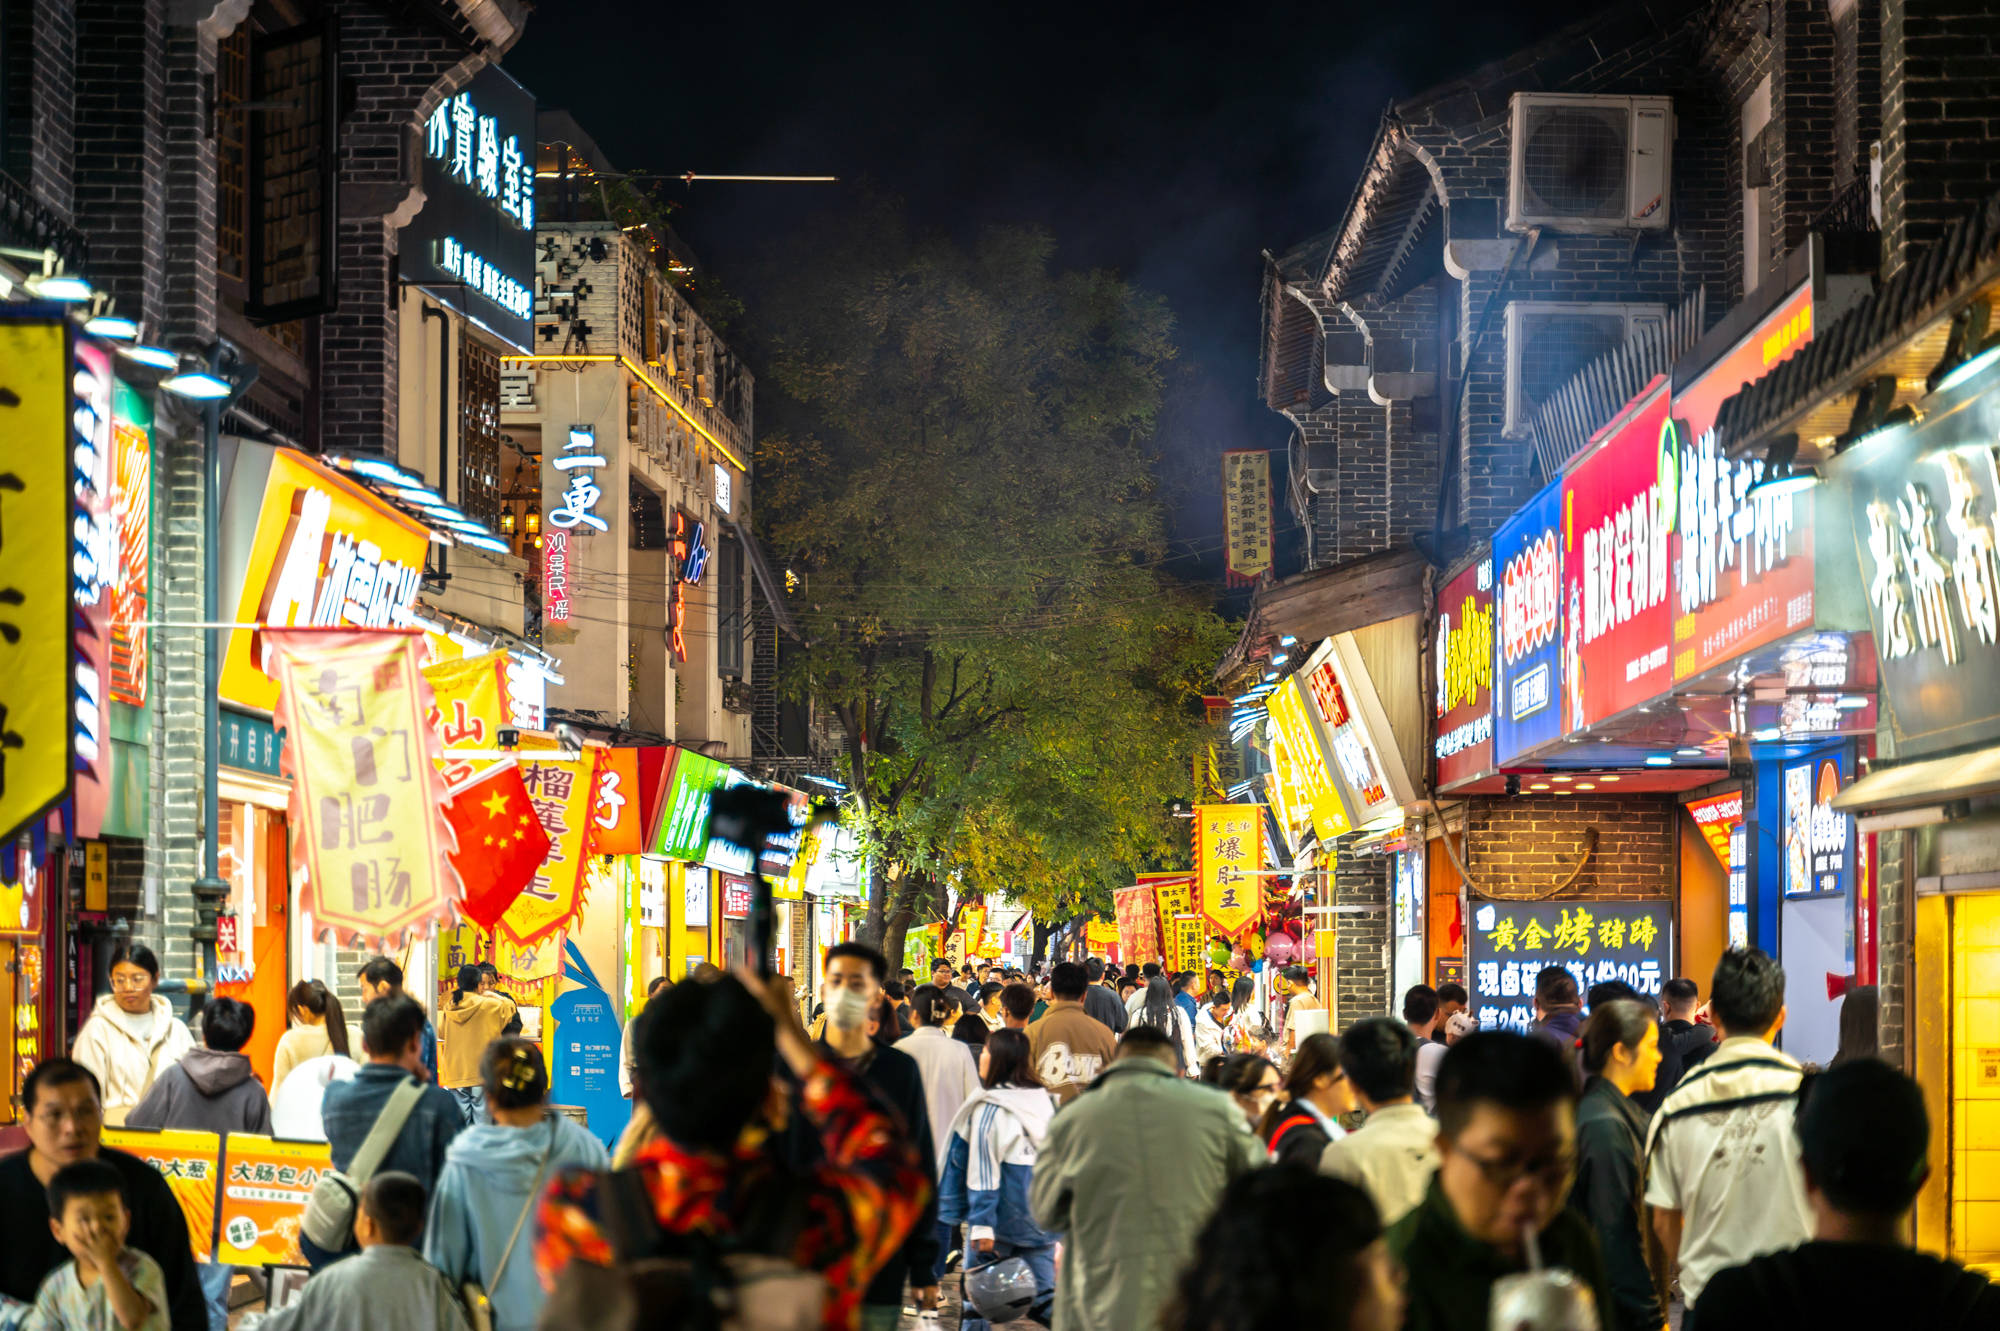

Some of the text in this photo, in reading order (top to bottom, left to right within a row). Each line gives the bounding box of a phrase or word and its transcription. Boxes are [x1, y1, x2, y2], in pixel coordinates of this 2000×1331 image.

[549, 430, 609, 532] 二更
[547, 532, 570, 621] 观景民谣
[1213, 838, 1247, 909] 爆肚王
[1487, 906, 1658, 955] 黄金烤猪蹄
[232, 1163, 331, 1186] 大肠包小
